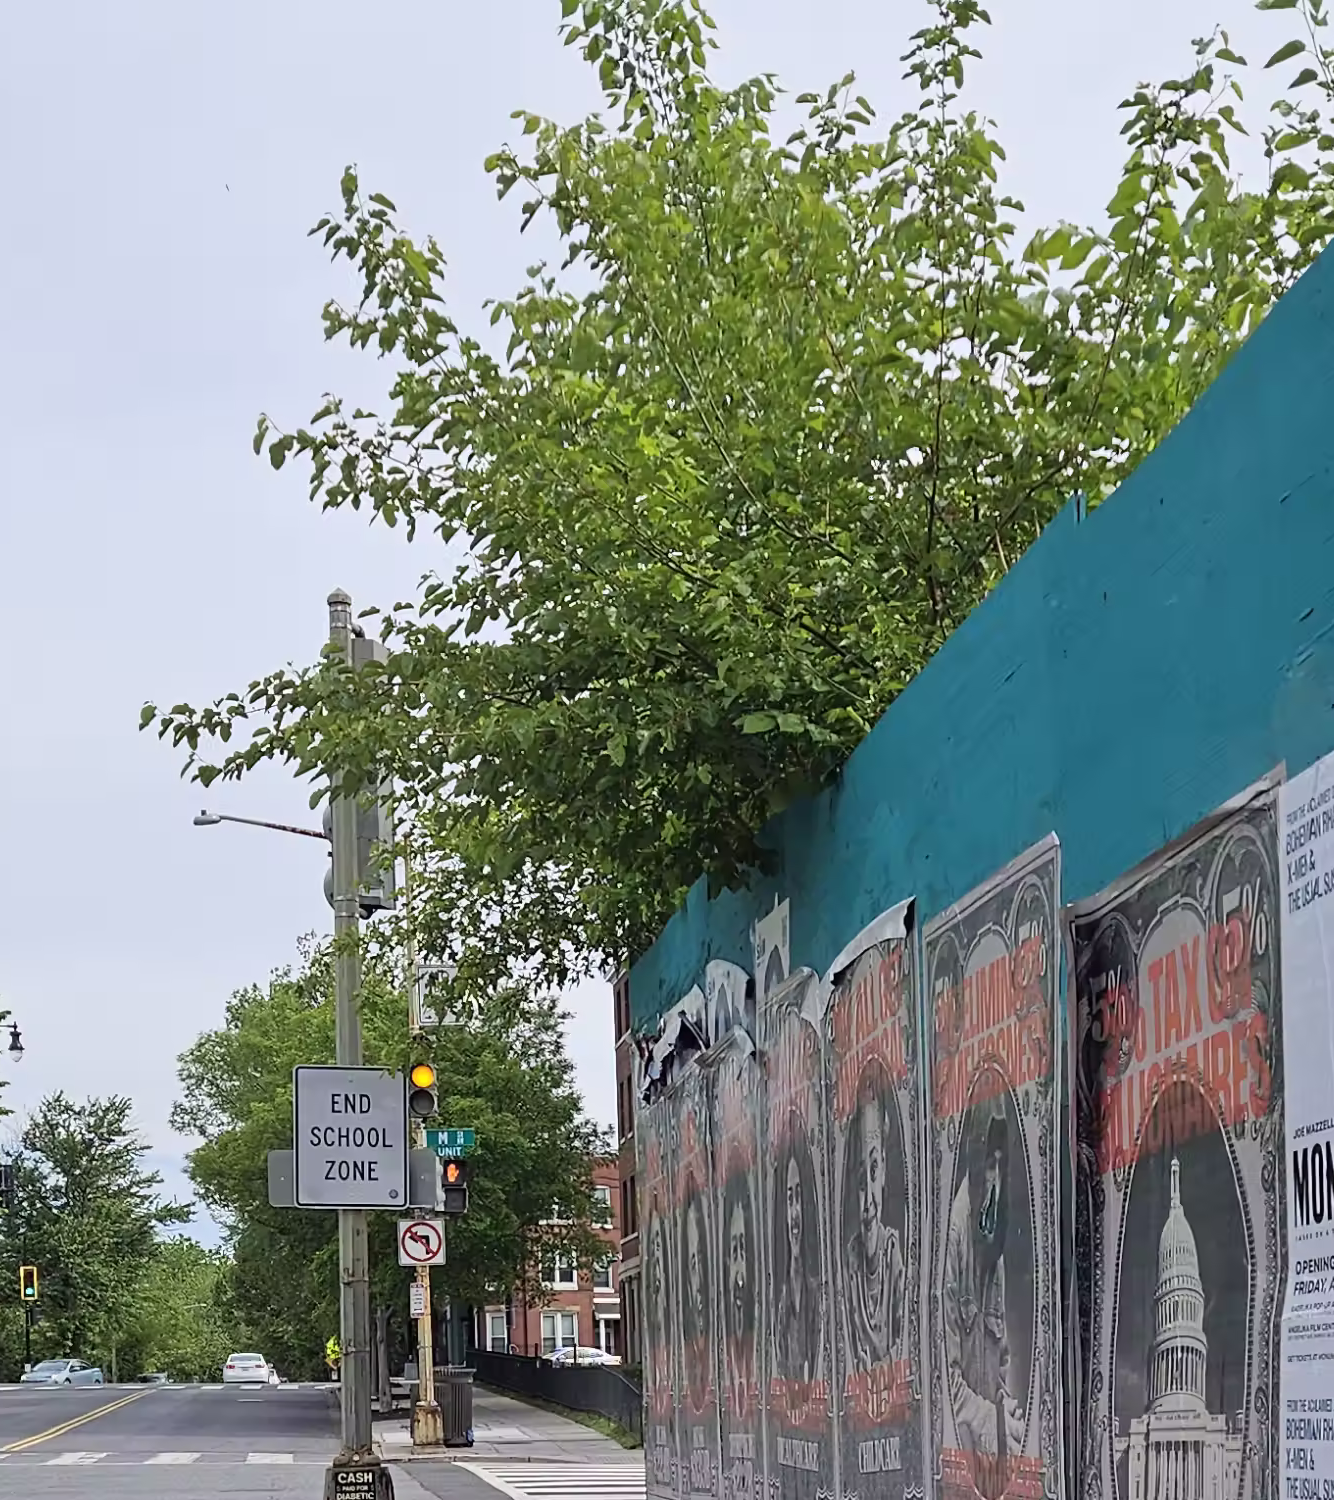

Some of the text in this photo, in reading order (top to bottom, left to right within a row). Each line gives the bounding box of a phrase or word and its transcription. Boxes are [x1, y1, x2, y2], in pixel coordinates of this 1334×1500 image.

[1147, 934, 1203, 1054] TAX
[331, 1094, 371, 1113] END
[310, 1127, 393, 1147] SCHOOL
[438, 1132, 448, 1144] M
[438, 1147, 462, 1156] UNIT
[325, 1161, 378, 1180] ZONE
[1293, 1276, 1327, 1296] FRIDAY,
[859, 1437, 902, 1474] CHILDCARE
[338, 1472, 372, 1484] CASH
[337, 1492, 374, 1500] DIABETIC
